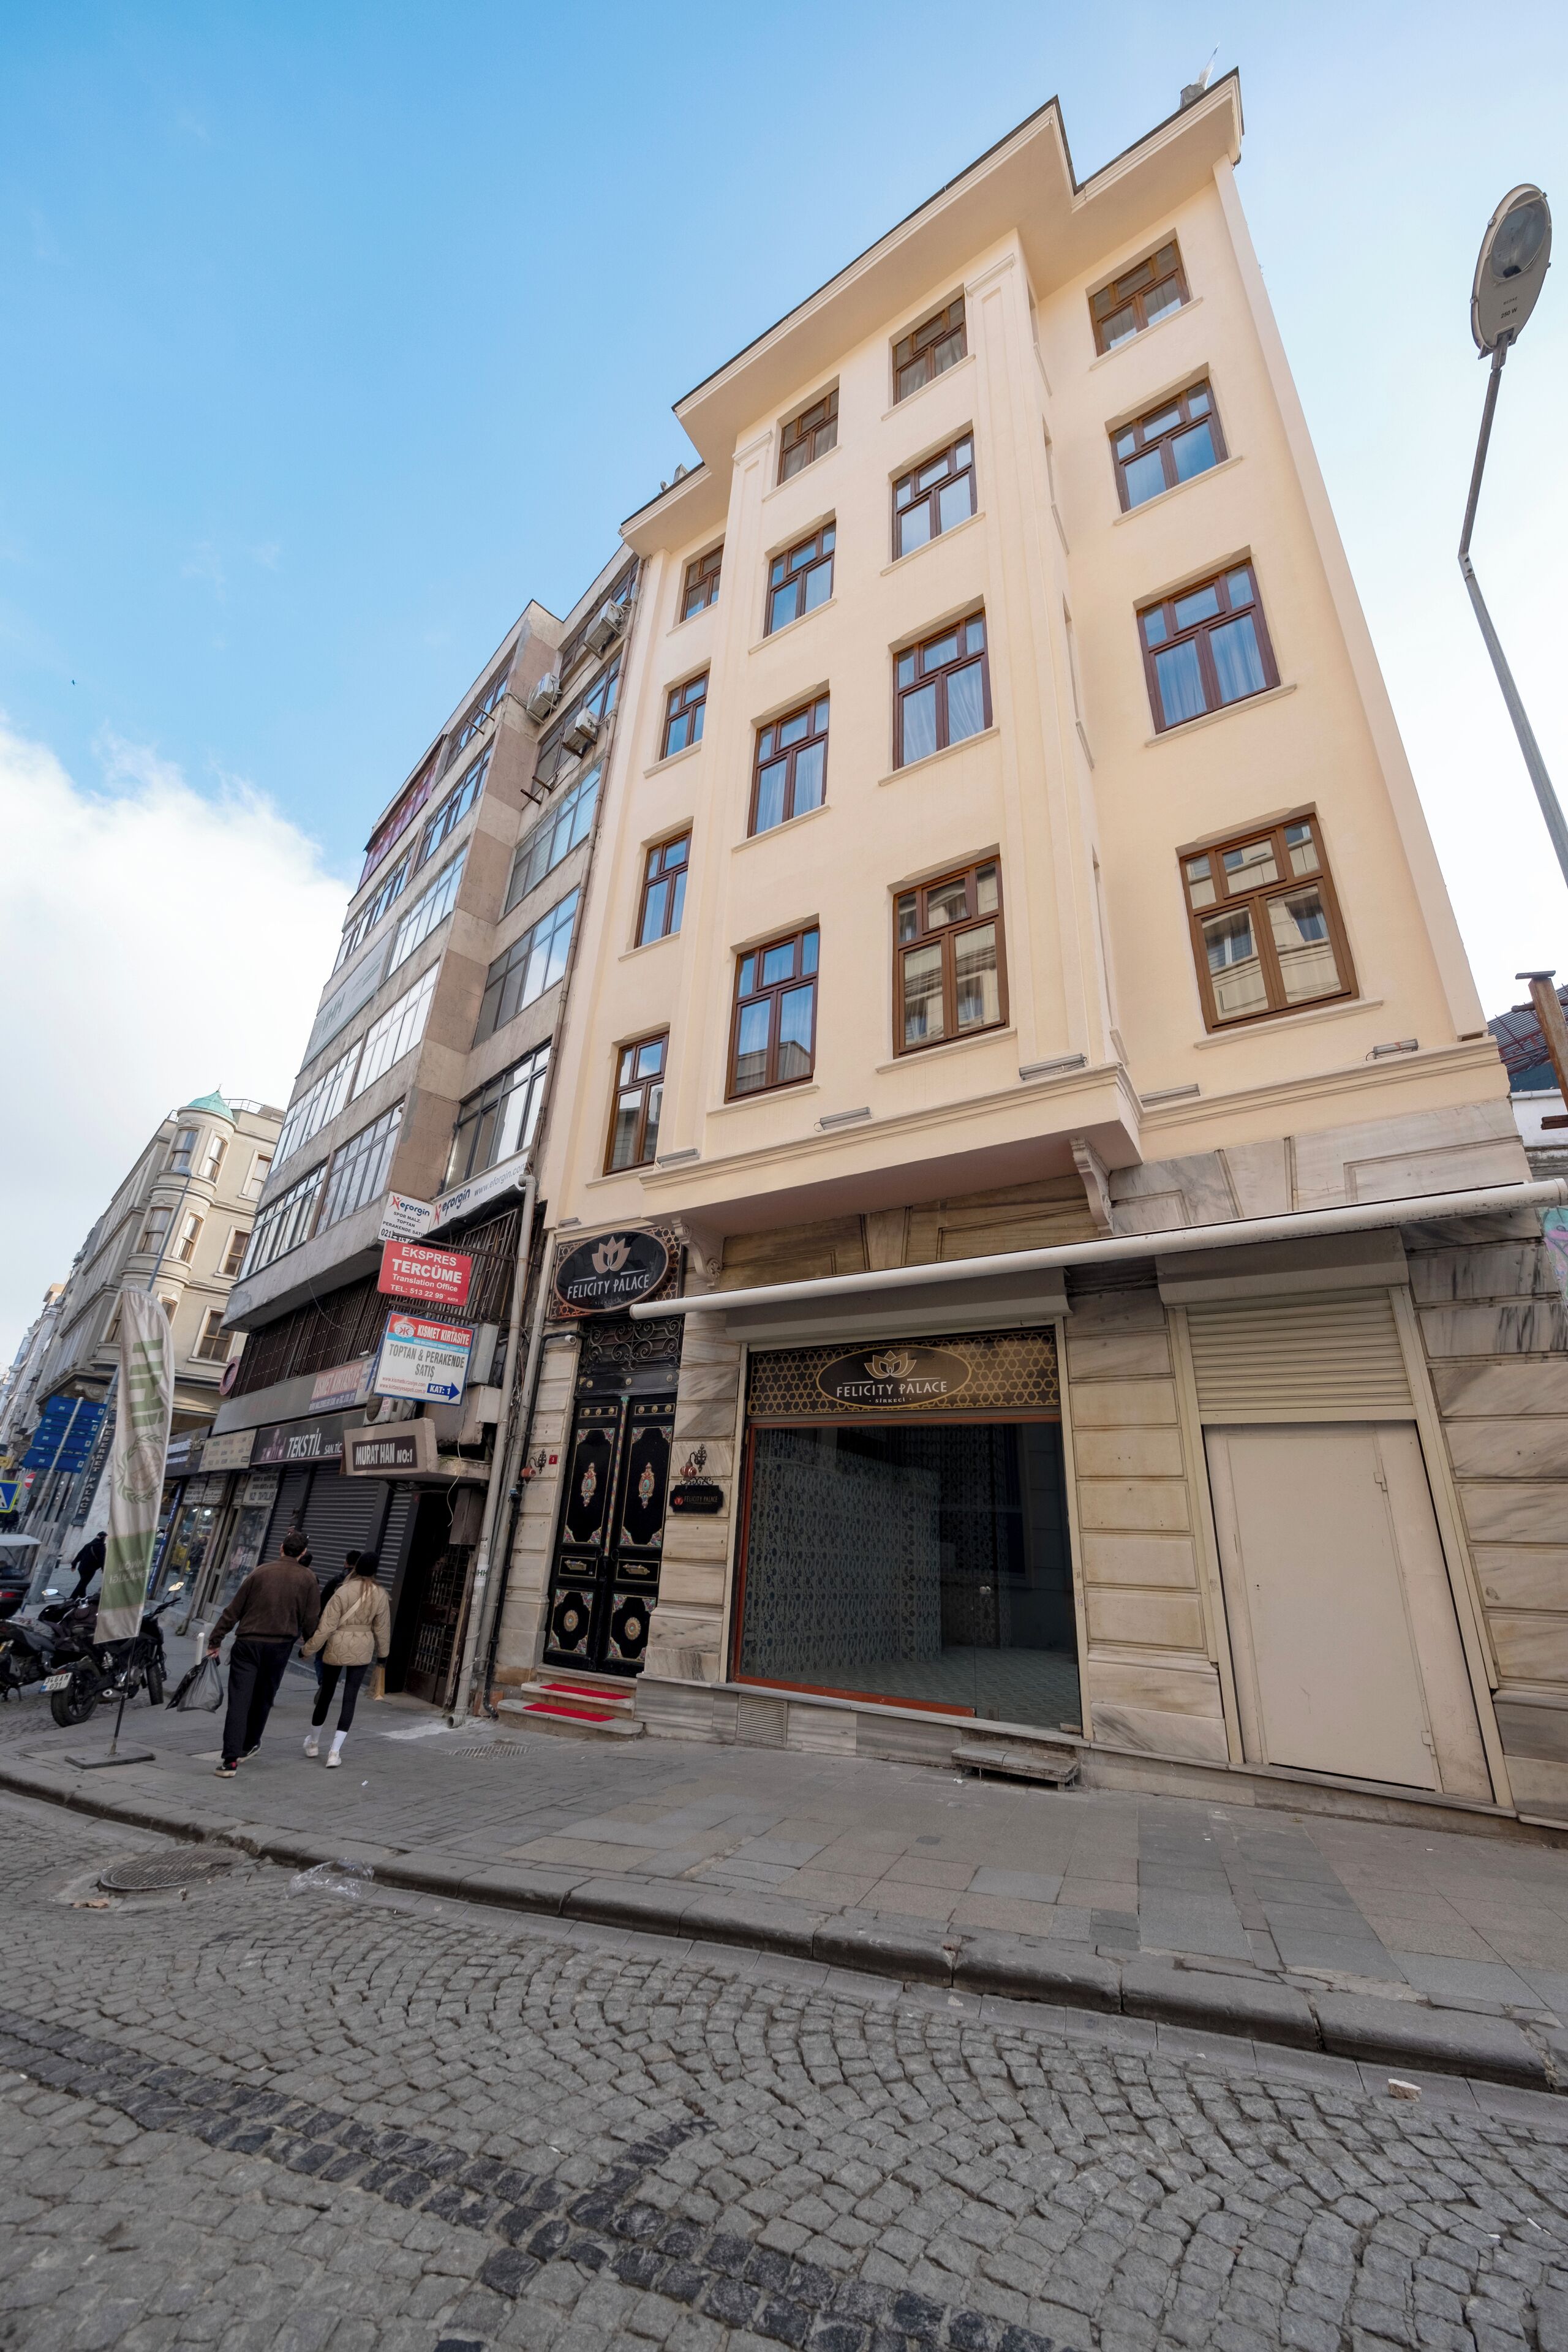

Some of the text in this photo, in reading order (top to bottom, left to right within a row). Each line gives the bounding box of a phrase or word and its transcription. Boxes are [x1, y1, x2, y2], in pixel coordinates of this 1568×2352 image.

[382, 1221, 411, 1233] PERAKENDE
[397, 1218, 415, 1227] TOPTAN
[401, 1246, 457, 1267] EKSPRES
[392, 1258, 462, 1284] TERCÜME
[391, 1284, 408, 1293] TEL:
[393, 1273, 458, 1292] Translation Office
[567, 1274, 649, 1300] FELICITY PALACE
[417, 1325, 441, 1340] KISMET
[440, 1330, 470, 1345] KIRTASİYE
[389, 1344, 465, 1368] TOPTAN & PERAKENDE
[415, 1363, 435, 1381] SATIŞ
[430, 1385, 445, 1394] KAT:
[837, 1381, 948, 1397] FELICITY PALACE
[93, 1423, 116, 1472] MESERRET
[287, 1428, 322, 1458] TEKSTİL
[355, 1443, 413, 1465] MURAT HAN NO:1
[78, 1477, 97, 1515] PALACE
